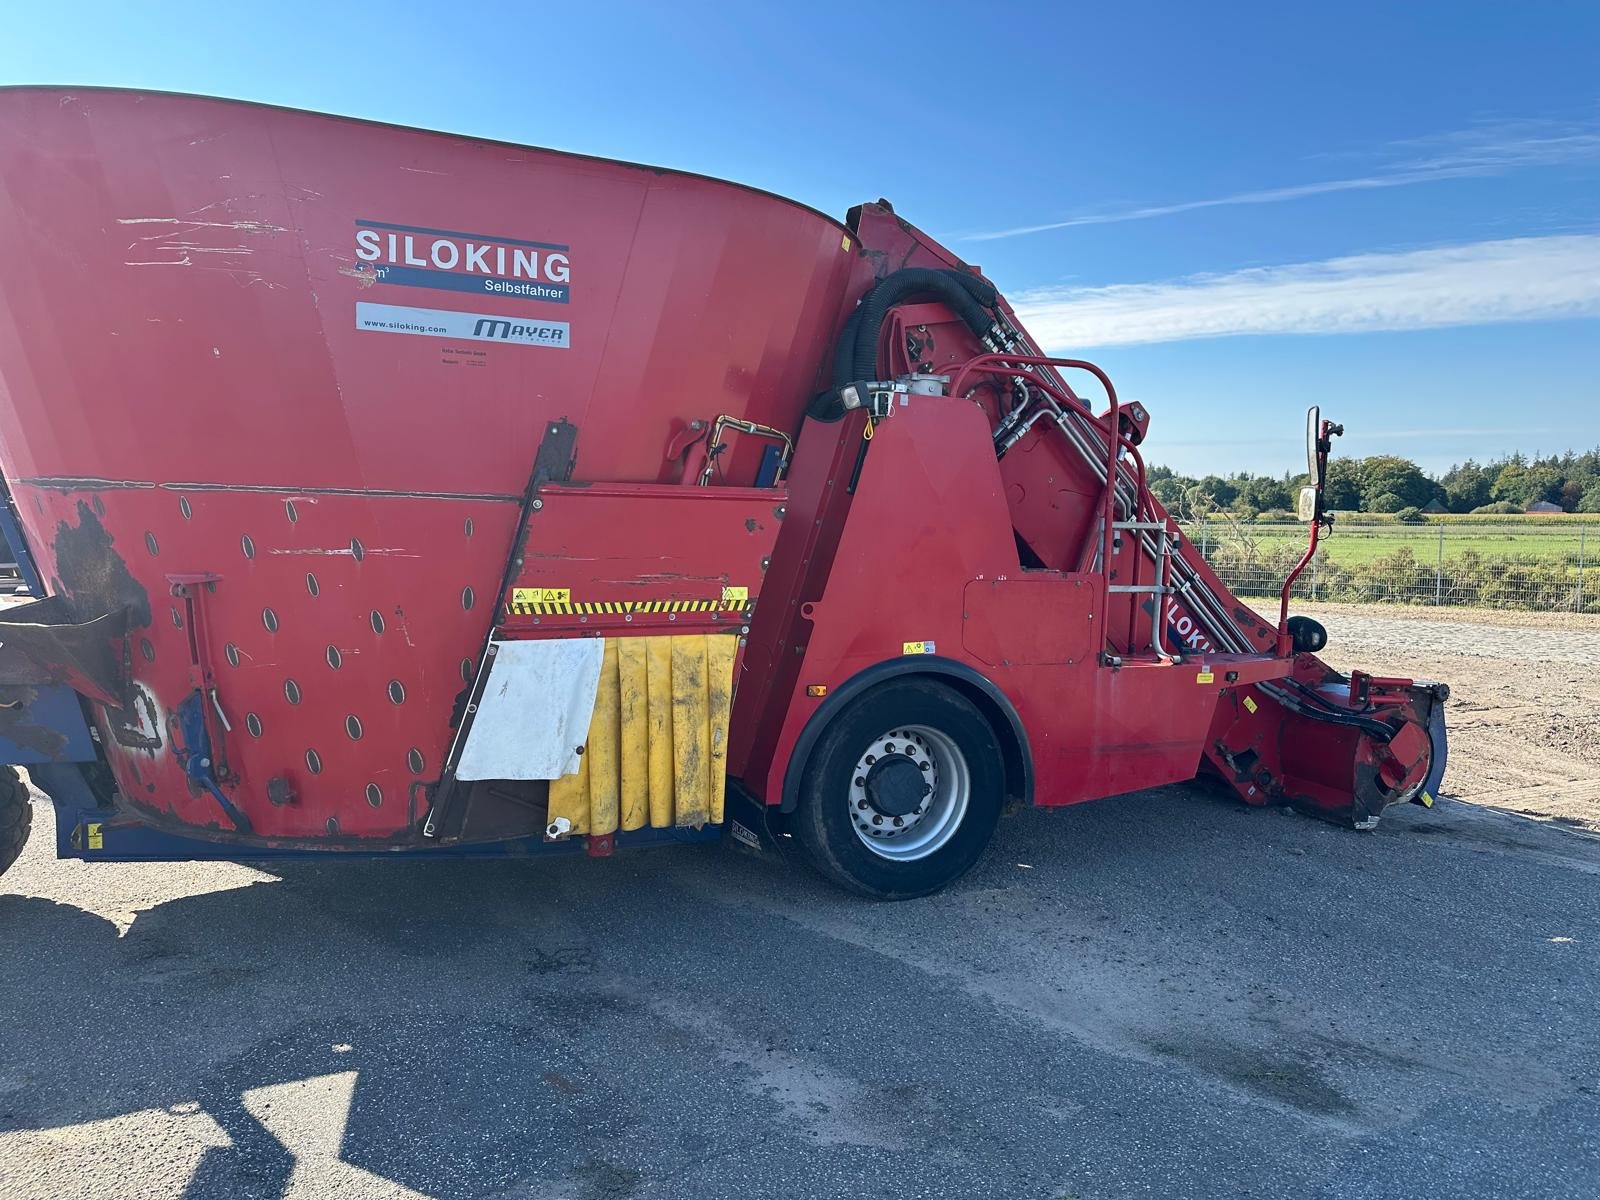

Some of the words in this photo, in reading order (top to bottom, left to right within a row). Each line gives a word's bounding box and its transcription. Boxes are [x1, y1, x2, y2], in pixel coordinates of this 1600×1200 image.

[355, 230, 570, 283] SILOKING
[484, 279, 563, 298] Selbstfahrer
[364, 320, 447, 333] www.siloking.com
[473, 319, 564, 340] MAYER
